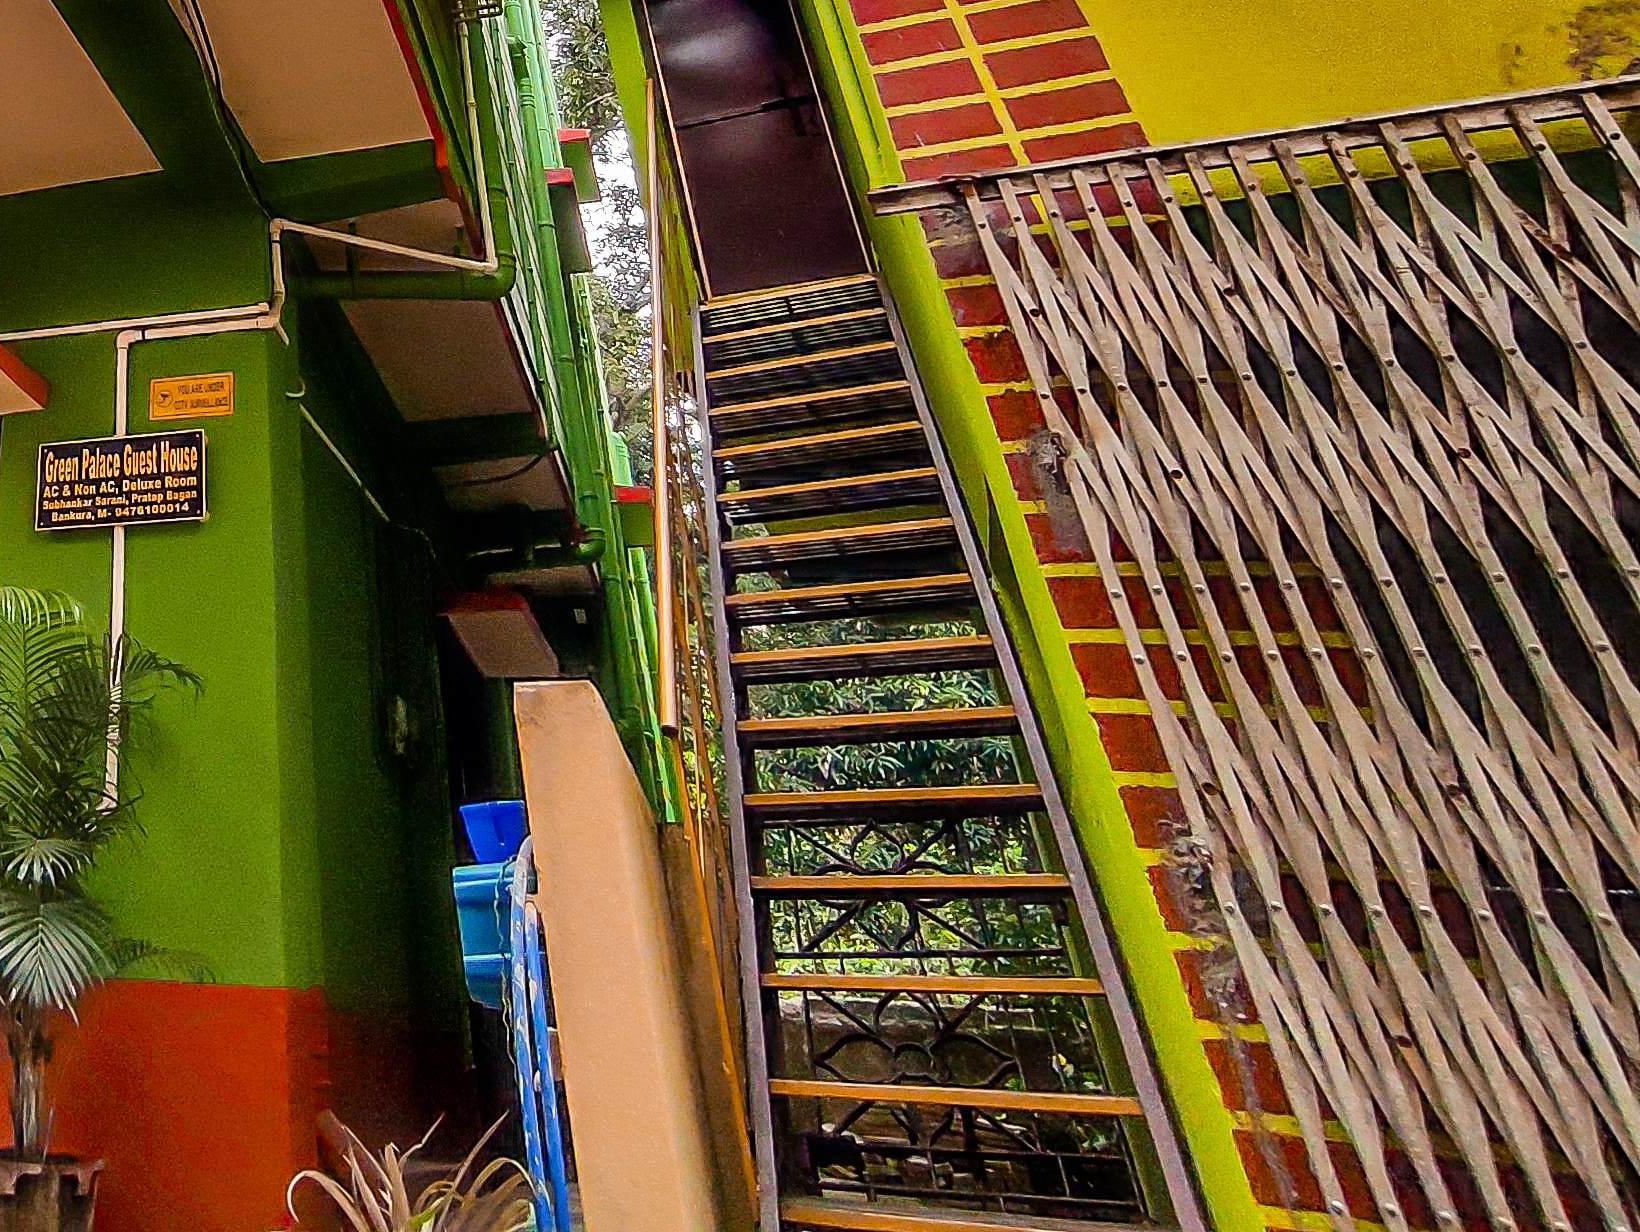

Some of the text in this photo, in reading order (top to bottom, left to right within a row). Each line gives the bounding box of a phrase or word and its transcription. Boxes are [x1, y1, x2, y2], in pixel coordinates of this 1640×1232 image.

[45, 440, 198, 483] Green Palace Guest House
[43, 474, 197, 498] AC & Non AC, Deluxe Room
[115, 502, 189, 517] 9476100014
